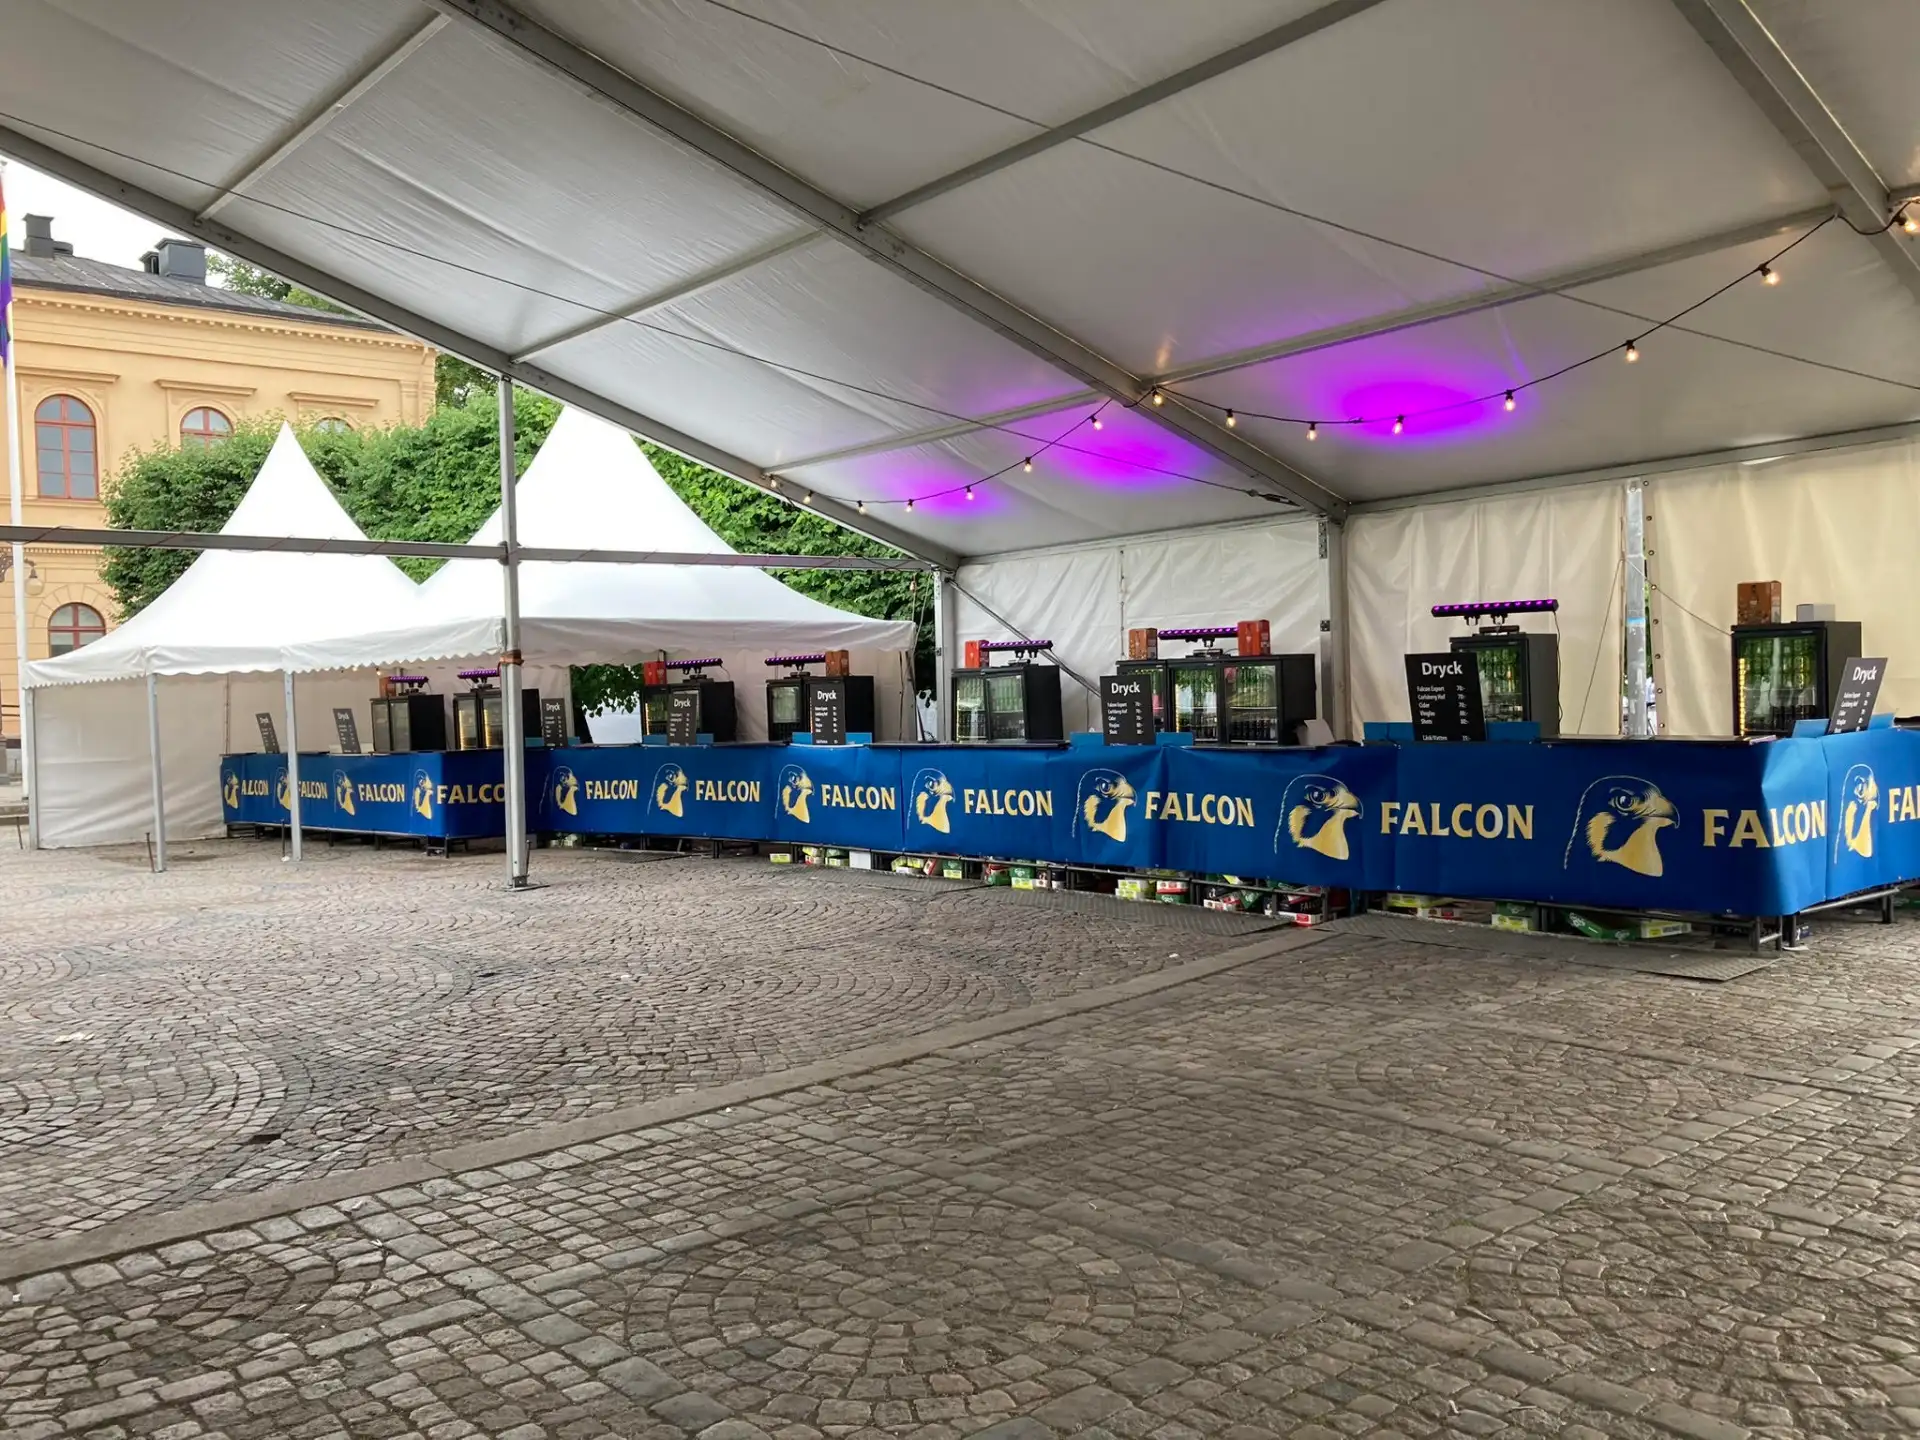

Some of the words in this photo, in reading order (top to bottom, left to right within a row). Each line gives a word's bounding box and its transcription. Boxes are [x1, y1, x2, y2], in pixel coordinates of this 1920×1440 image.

[1421, 660, 1464, 679] Dryck
[1852, 666, 1877, 685] Dryck
[817, 689, 837, 702] Dryck
[1111, 681, 1141, 696] Dryck
[673, 698, 691, 709] Dryck
[241, 779, 269, 796] ALCON
[358, 783, 405, 802] FALCON
[436, 783, 505, 804] FALCO
[585, 780, 638, 800] FALCON
[695, 780, 760, 802] FALCON
[821, 783, 896, 810] FALCON
[964, 788, 1053, 817] FALCON
[1145, 791, 1255, 827] FALCON
[1380, 801, 1534, 841] FALCON
[1702, 799, 1826, 848] FALCON
